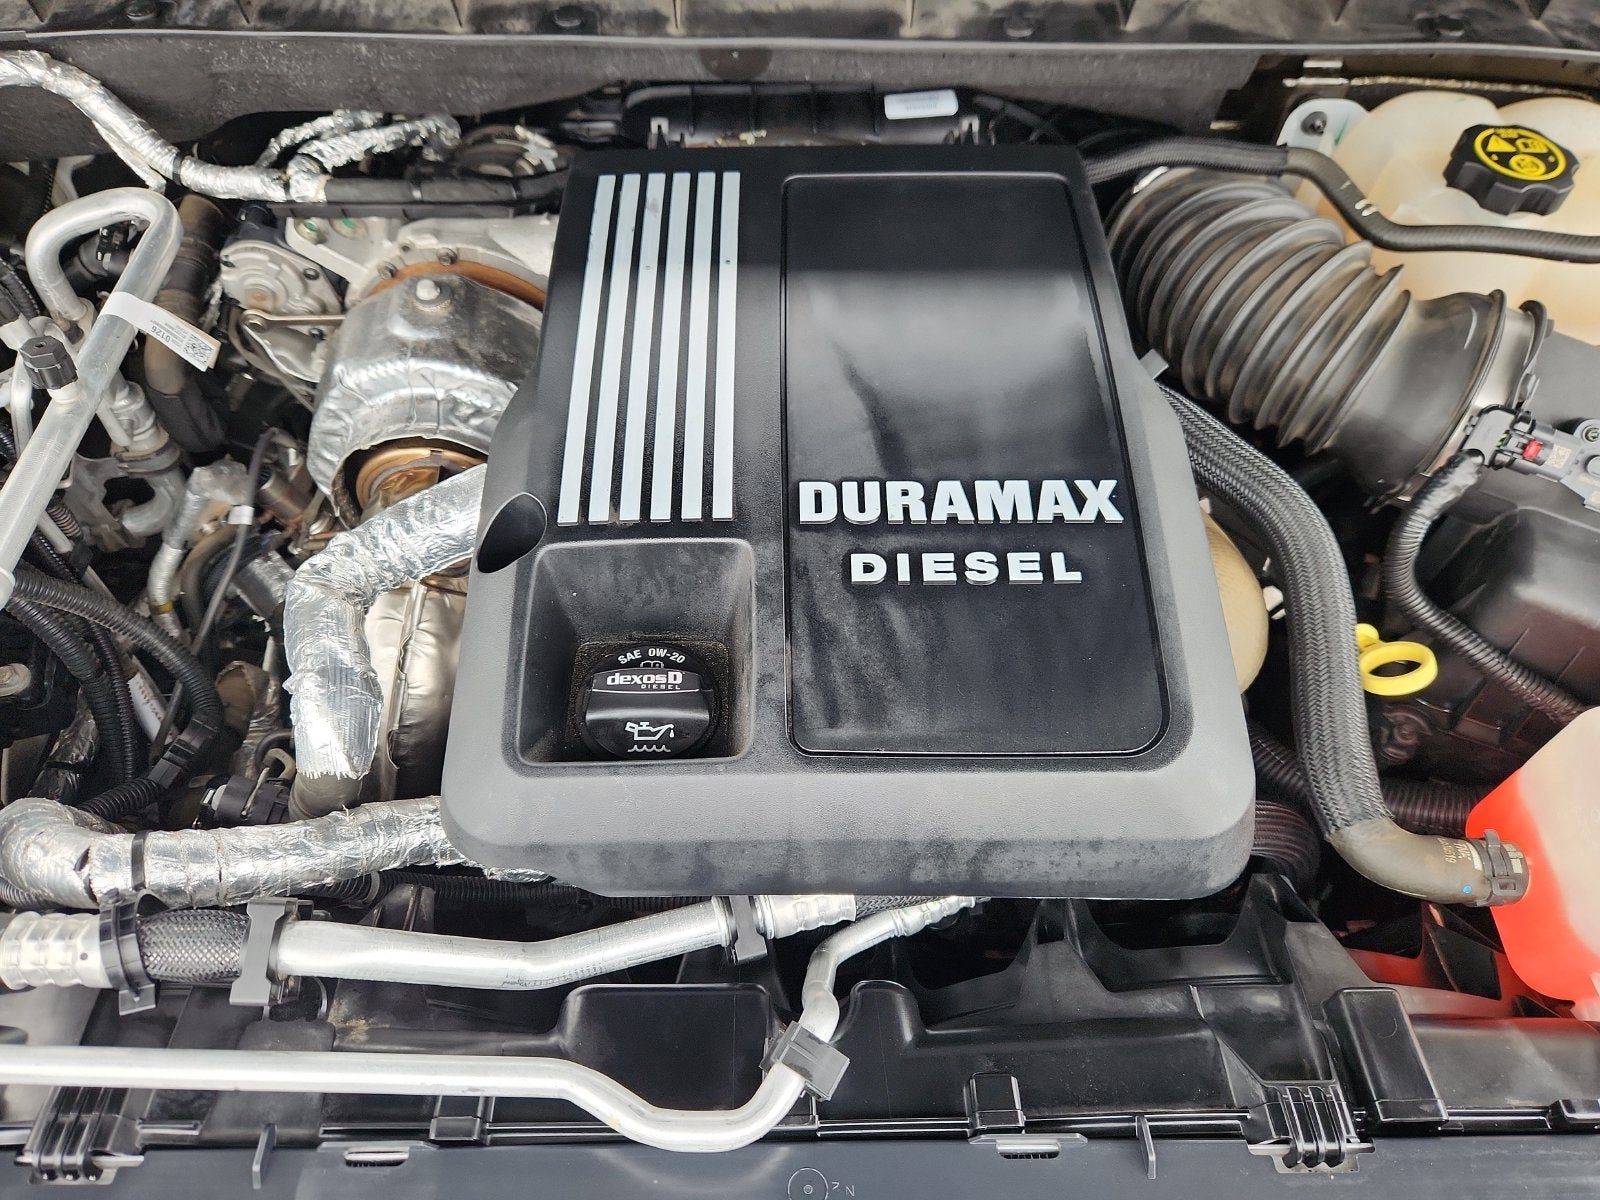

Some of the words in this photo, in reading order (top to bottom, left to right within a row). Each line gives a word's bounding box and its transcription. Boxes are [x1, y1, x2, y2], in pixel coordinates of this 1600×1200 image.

[798, 480, 1124, 524] DURAMAX
[850, 551, 1082, 585] DIESEL
[617, 649, 642, 664] SAE
[648, 648, 686, 664] 0W-20
[607, 672, 683, 685] dexosD
